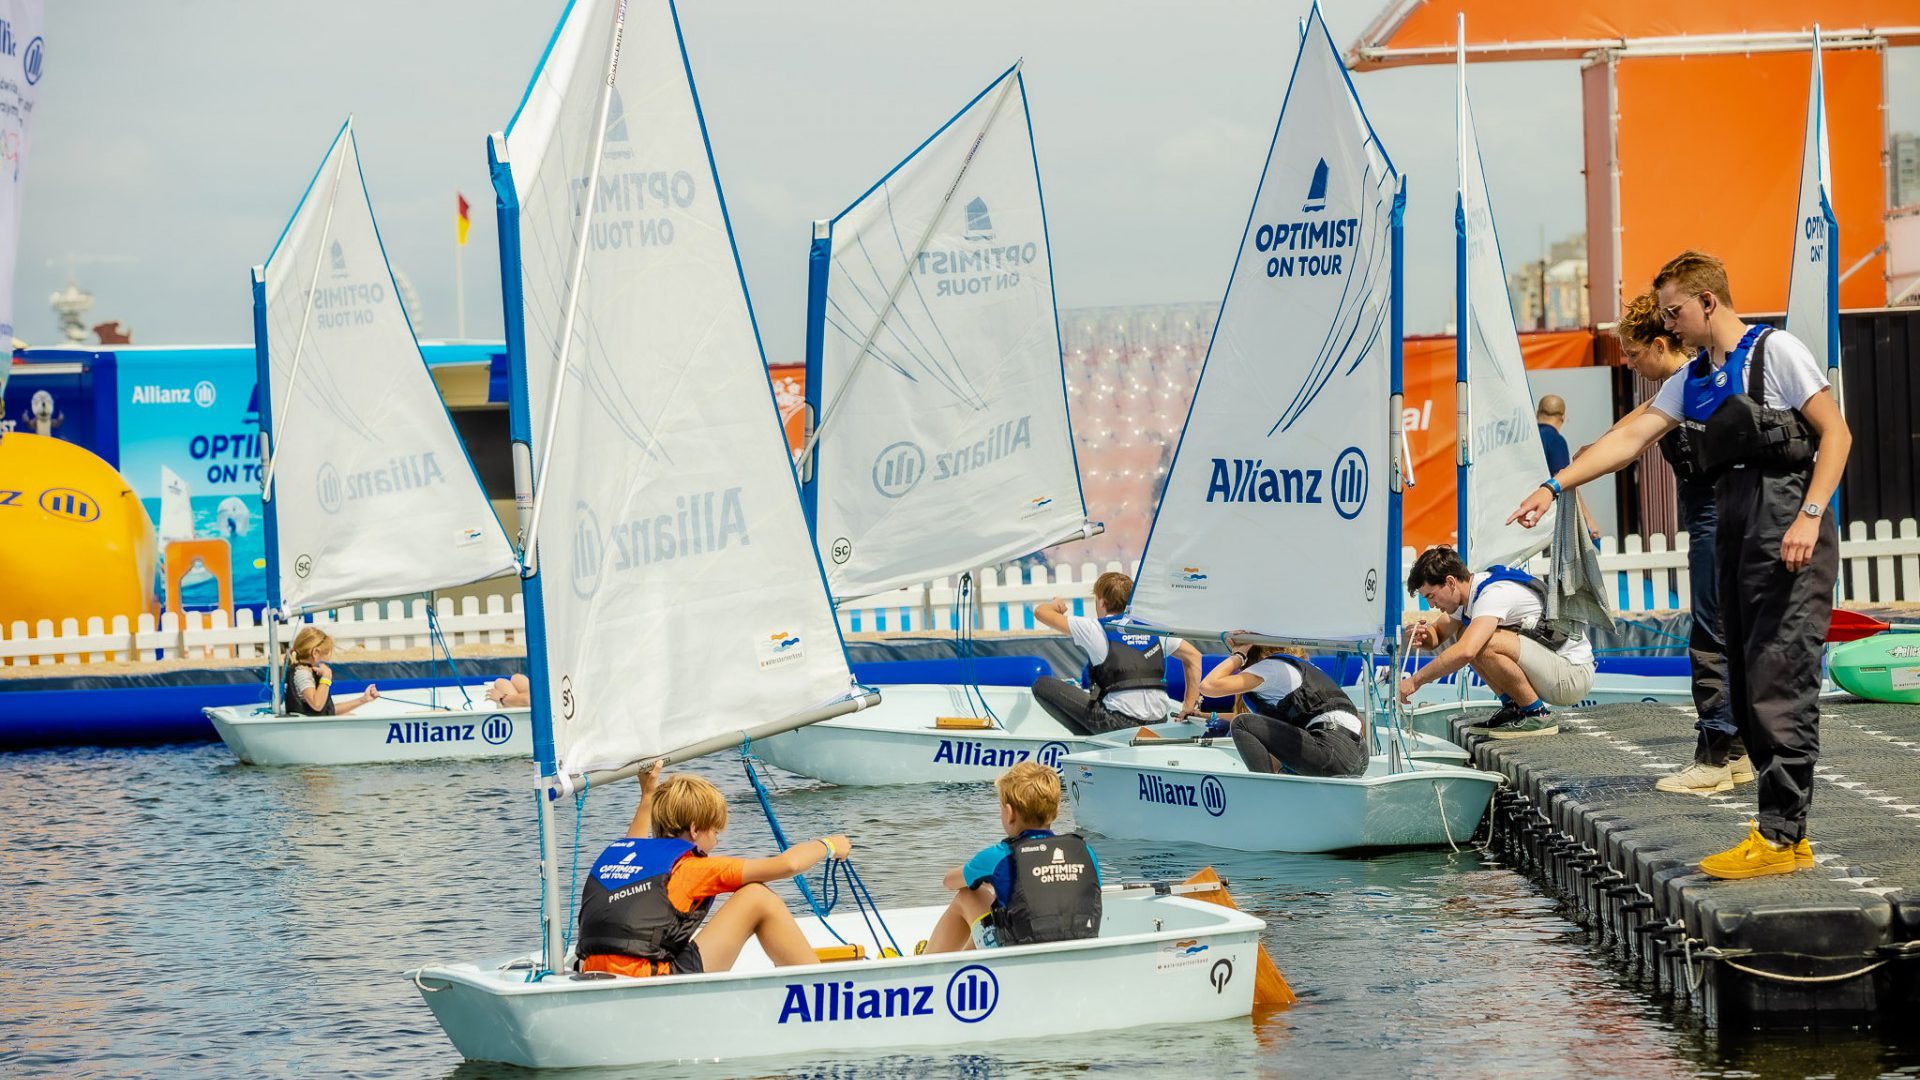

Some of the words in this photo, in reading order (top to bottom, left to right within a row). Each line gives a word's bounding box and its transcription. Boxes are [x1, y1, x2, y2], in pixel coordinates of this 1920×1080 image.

[1255, 218, 1359, 253] OPTIMIST
[1267, 256, 1295, 278] ON
[1298, 254, 1342, 277] TOUR
[132, 385, 192, 404] Allianz
[189, 434, 261, 460] OPTI
[207, 464, 238, 483] ON
[1206, 458, 1323, 504] Allianz
[834, 545, 849, 557] SC
[1366, 577, 1376, 592] SC
[386, 721, 475, 744] Allianz
[933, 739, 1031, 767] Allianz
[1137, 772, 1199, 807] Allianz
[599, 864, 644, 874] OPTIMIST
[1032, 863, 1085, 877] OPTIMIST
[1040, 874, 1055, 883] ON
[1055, 873, 1078, 882] TOUR
[608, 881, 652, 904] PROLIMIT
[777, 980, 934, 1024] Allianz
